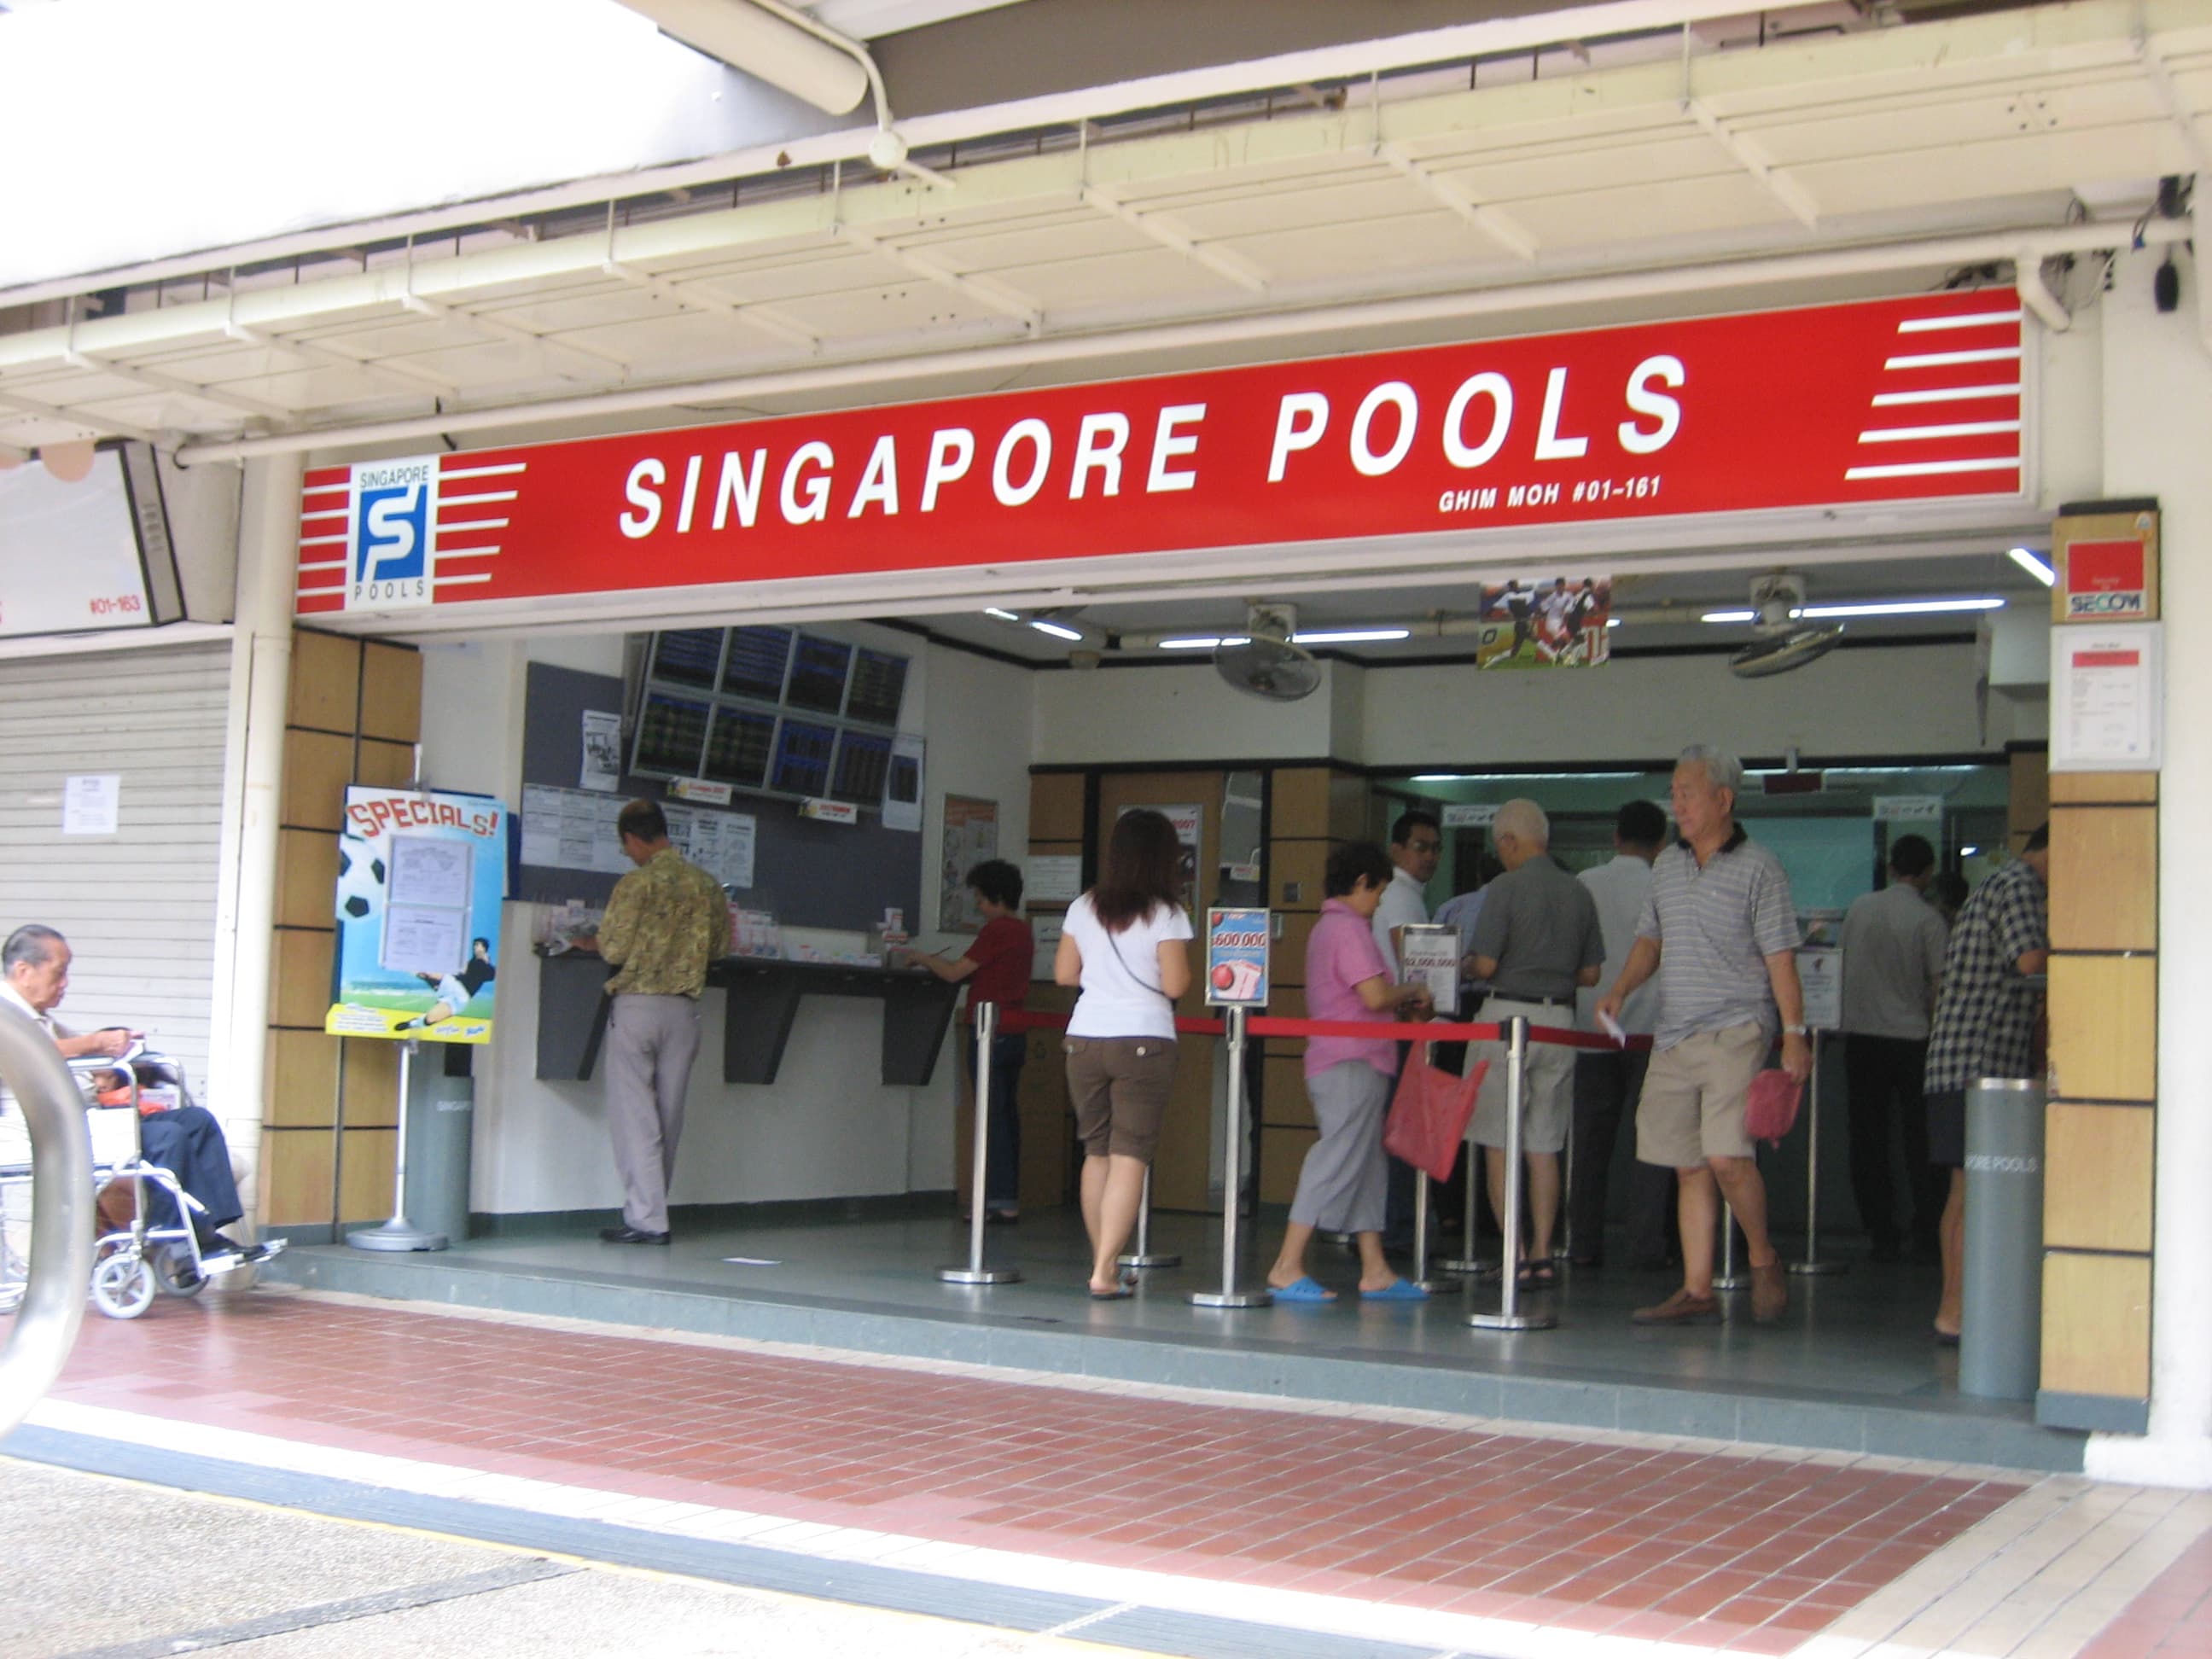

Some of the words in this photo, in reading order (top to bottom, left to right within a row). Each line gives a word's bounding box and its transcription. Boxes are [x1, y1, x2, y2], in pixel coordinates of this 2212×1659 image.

[620, 403, 1207, 538] SINGAPORE
[1267, 355, 1685, 482] POOLS
[360, 465, 429, 489] SINGAPORE
[1439, 487, 1498, 512] GHIM
[1507, 483, 1560, 507] MOH
[1572, 474, 1661, 503] #01-161
[355, 579, 425, 601] POOLS
[90, 595, 142, 615] #01-163
[2071, 592, 2141, 613] SECOM
[346, 798, 498, 837] SPECIALS!
